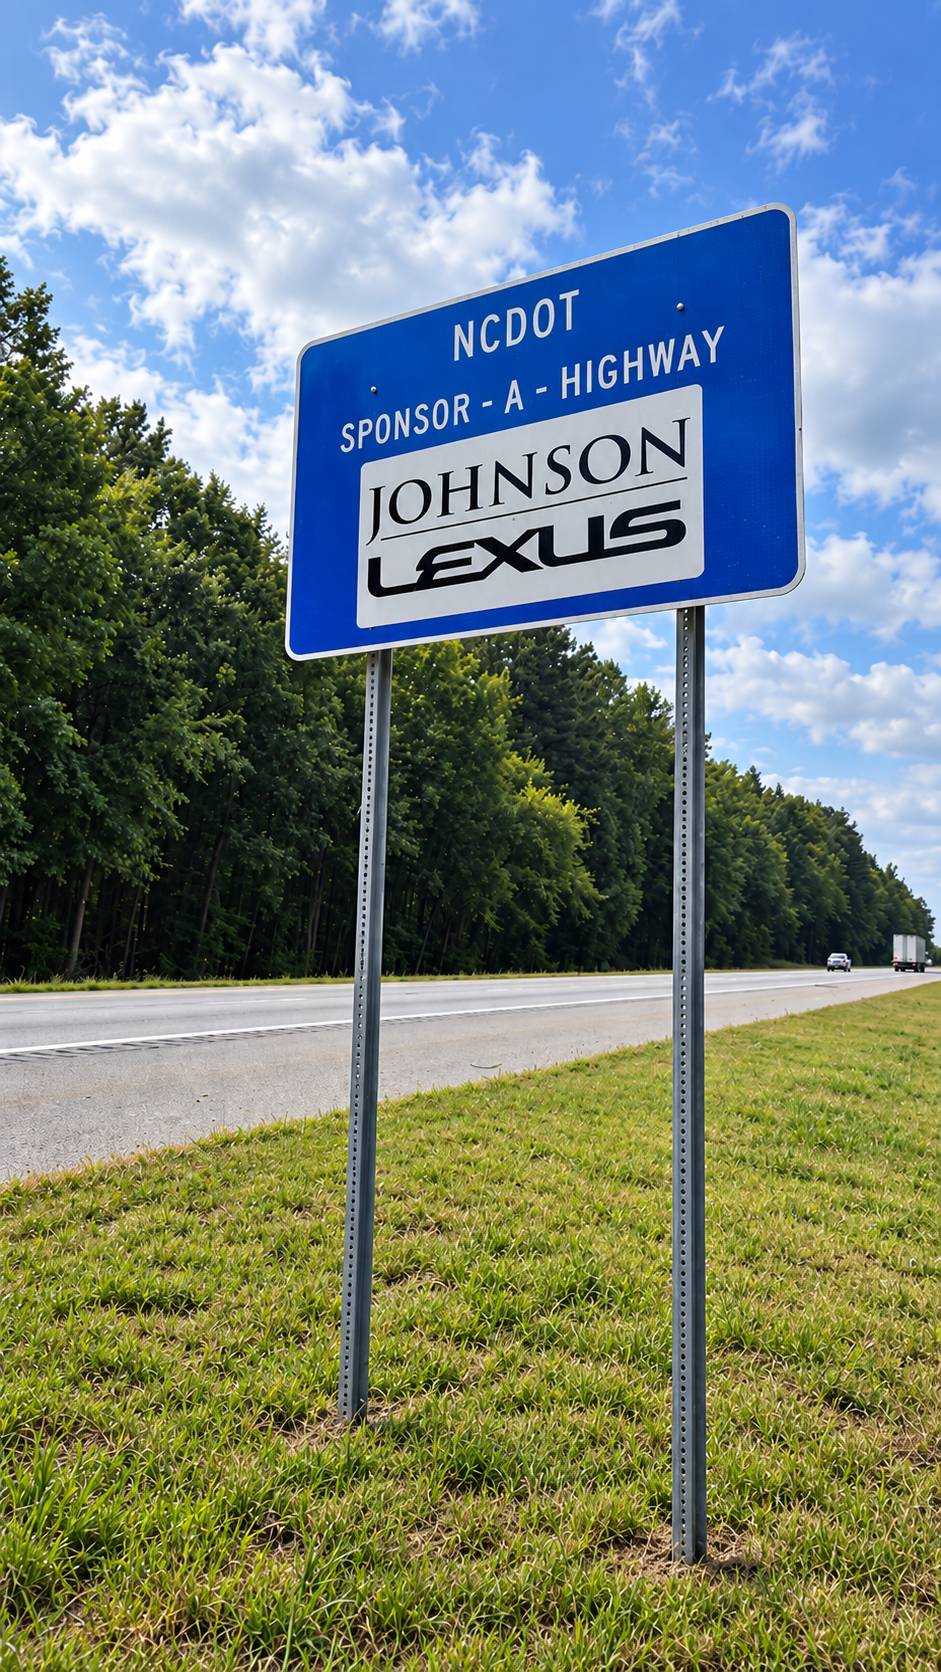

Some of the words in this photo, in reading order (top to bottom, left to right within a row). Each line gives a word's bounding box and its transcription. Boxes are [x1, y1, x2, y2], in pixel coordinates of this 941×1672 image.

[453, 289, 580, 361] NCDOT
[340, 393, 470, 453] SPONSOR
[504, 379, 524, 415] A
[561, 326, 725, 400] HIGHWAY
[365, 417, 691, 546] JOHNSON
[367, 499, 687, 598] LEXUS
